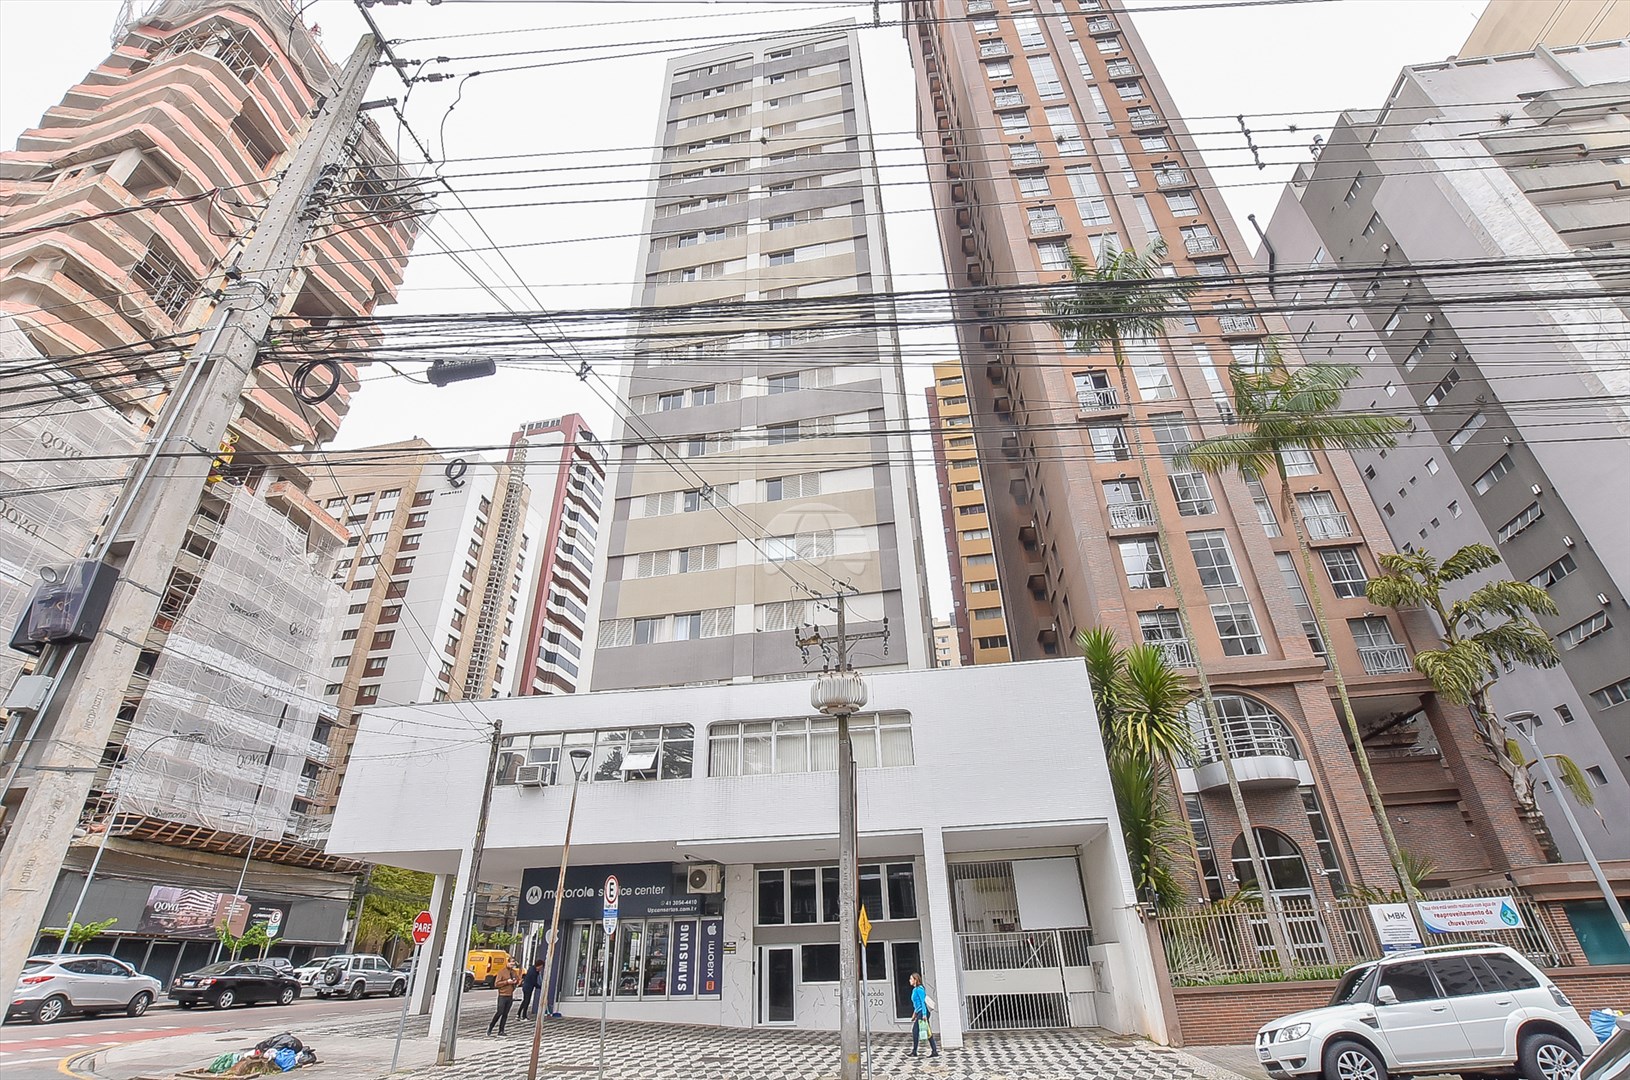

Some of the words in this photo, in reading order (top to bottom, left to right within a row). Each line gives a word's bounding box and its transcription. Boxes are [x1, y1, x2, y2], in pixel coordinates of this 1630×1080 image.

[598, 886, 632, 897] sice
[634, 885, 665, 896] center
[608, 882, 615, 898] E
[1387, 911, 1408, 920] MBK
[414, 922, 432, 934] PARE
[677, 924, 690, 992] SAMSUNG
[869, 998, 884, 1008] 520
